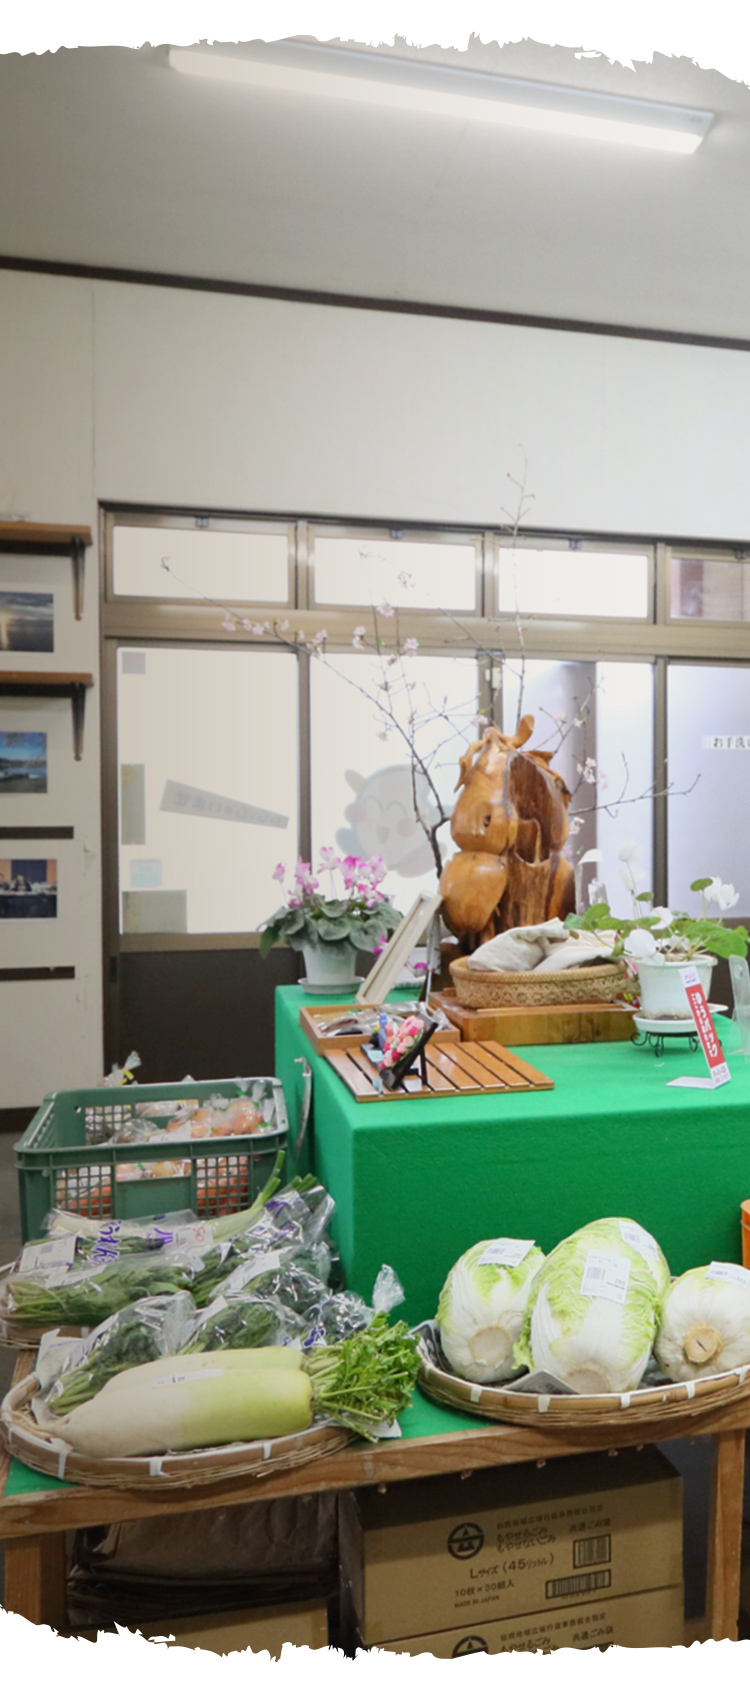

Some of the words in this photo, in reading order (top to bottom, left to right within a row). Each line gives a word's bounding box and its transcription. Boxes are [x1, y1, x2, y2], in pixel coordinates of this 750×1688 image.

[454, 1599, 471, 1609] MADE
[472, 1597, 479, 1605] IN
[480, 1594, 500, 1604] JAPAN
[572, 1625, 614, 1643] 共通ごみ袋
